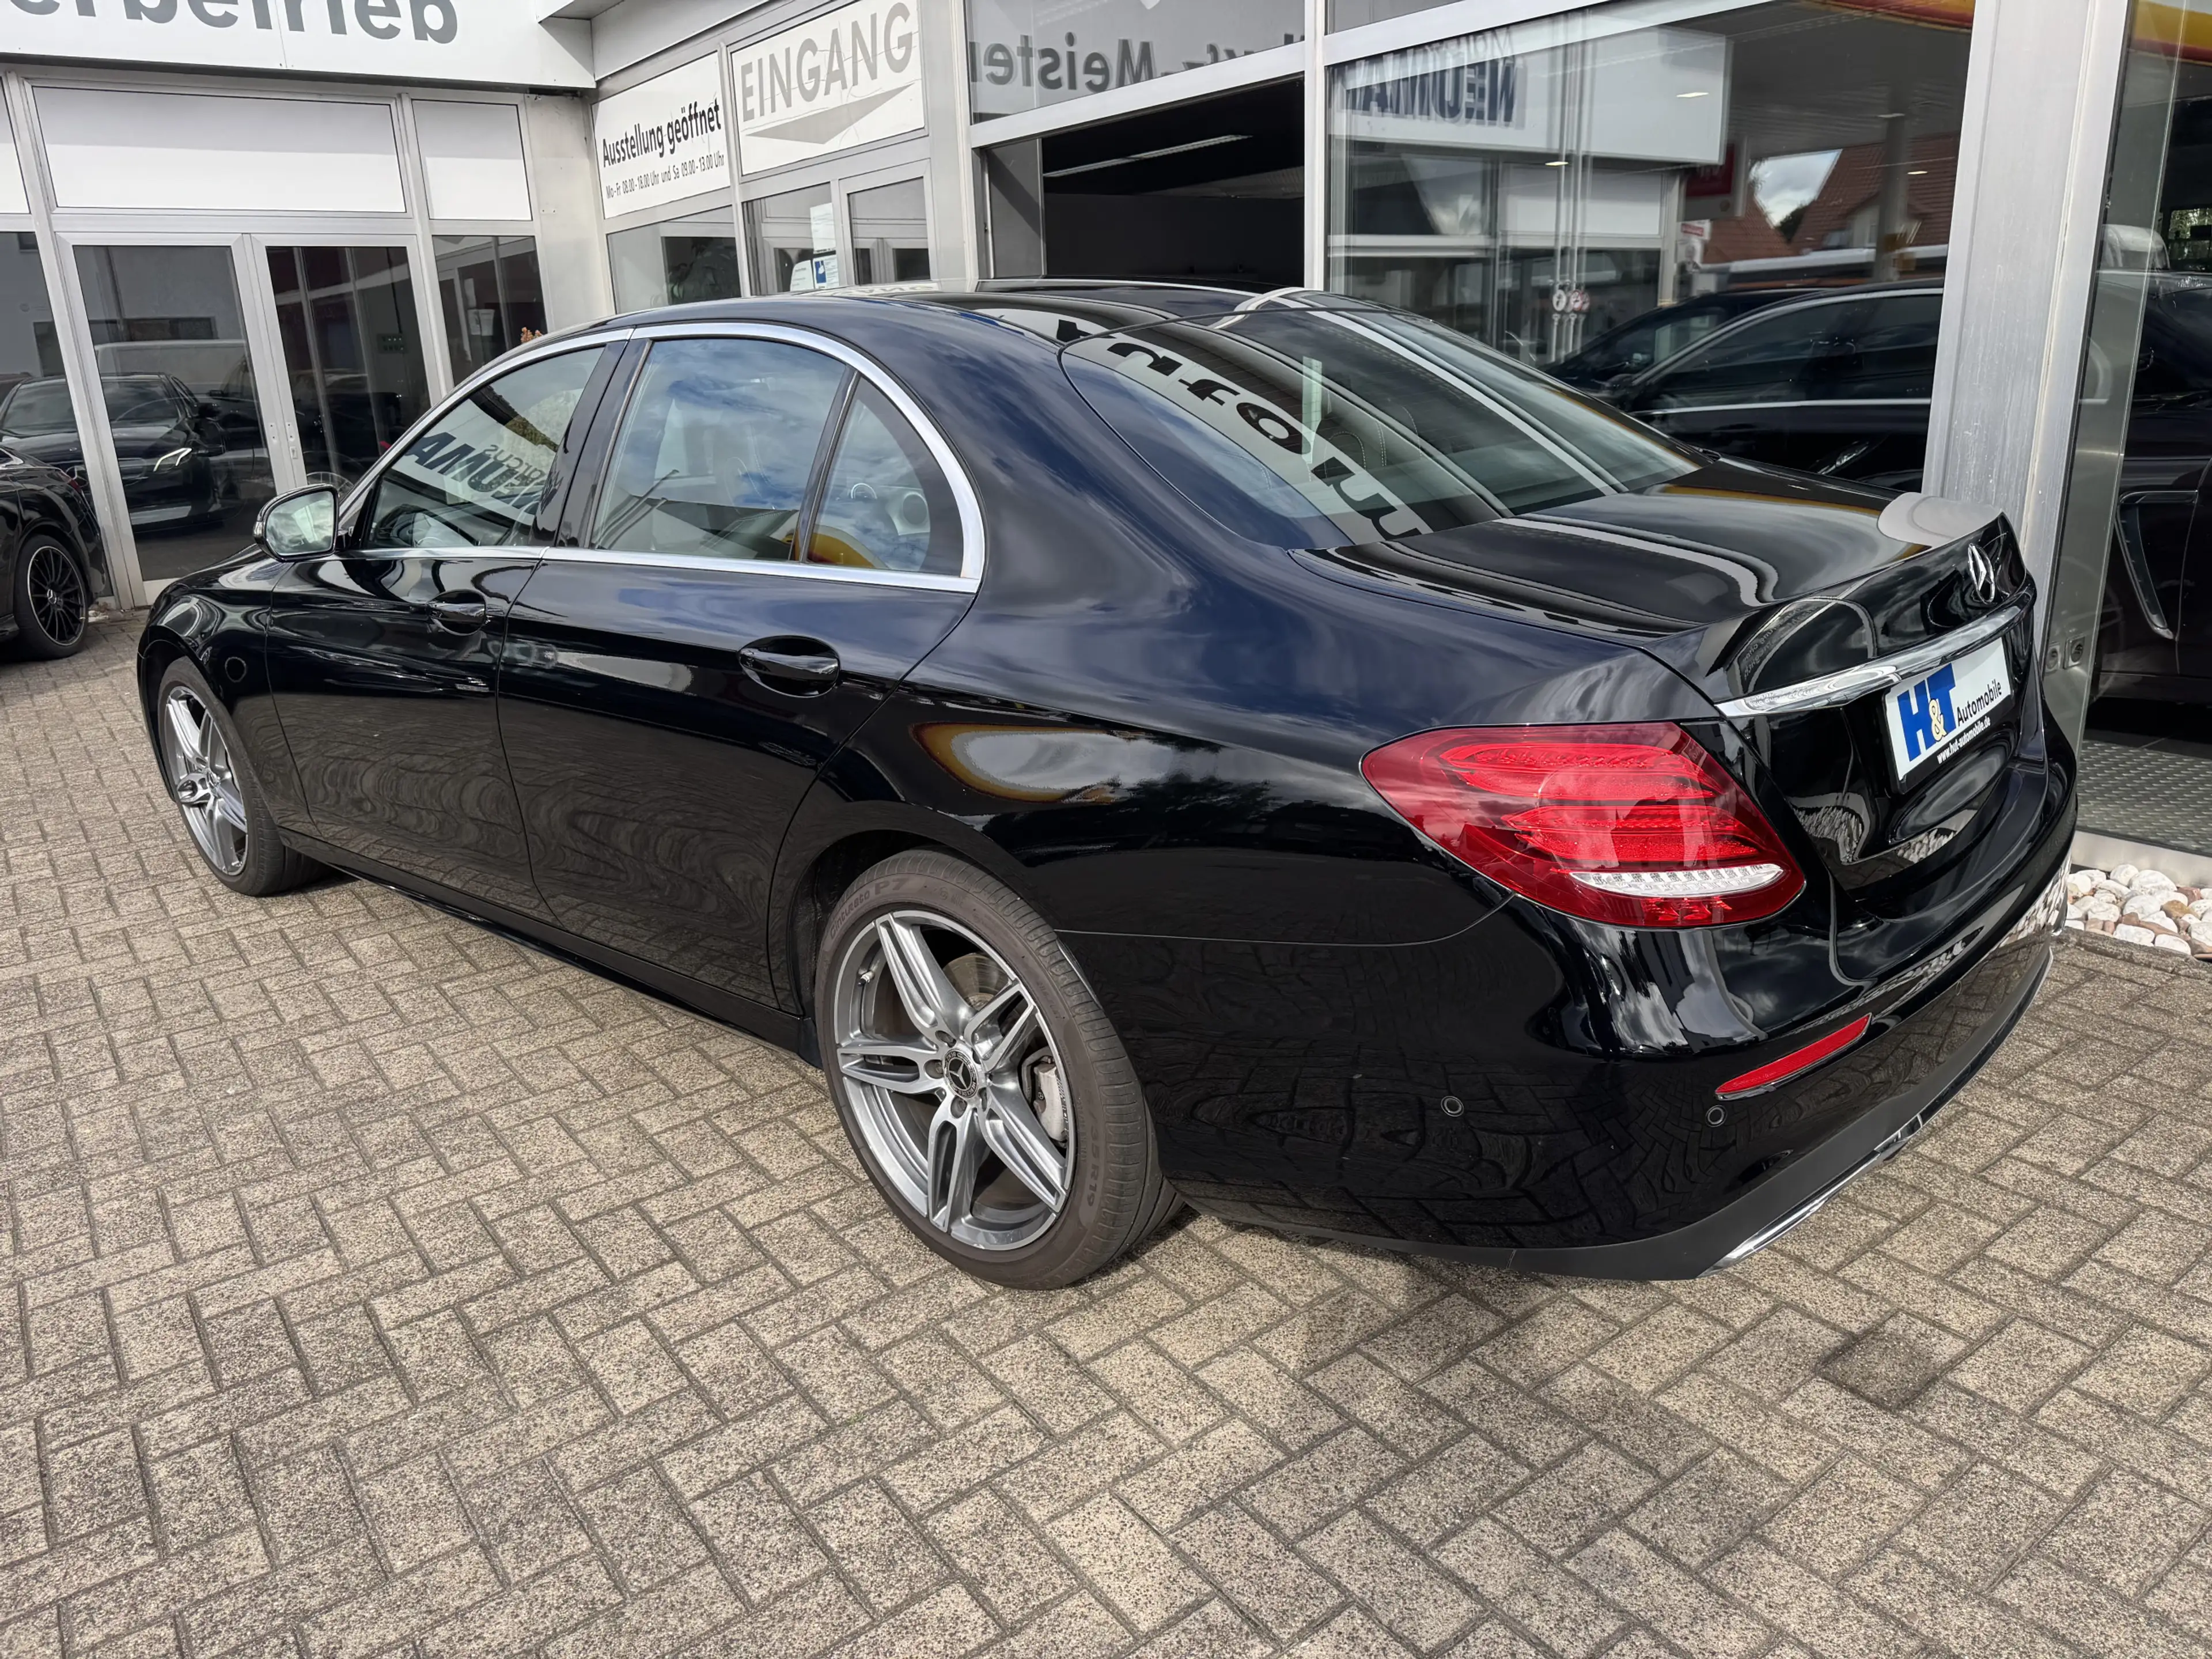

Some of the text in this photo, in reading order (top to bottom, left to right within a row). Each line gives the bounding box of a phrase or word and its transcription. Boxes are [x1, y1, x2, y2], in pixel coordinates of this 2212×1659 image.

[741, 2, 912, 122] EINGANG
[603, 98, 721, 167] Ausstellung geöffnet
[650, 171, 660, 186] Uhr
[661, 165, 672, 183] und
[673, 165, 680, 180] Sa
[713, 150, 724, 168] Uhr
[1897, 662, 2002, 762] H&T Automobile
[1937, 715, 1991, 764] www.hut-automobile.de
[874, 878, 908, 895] P7
